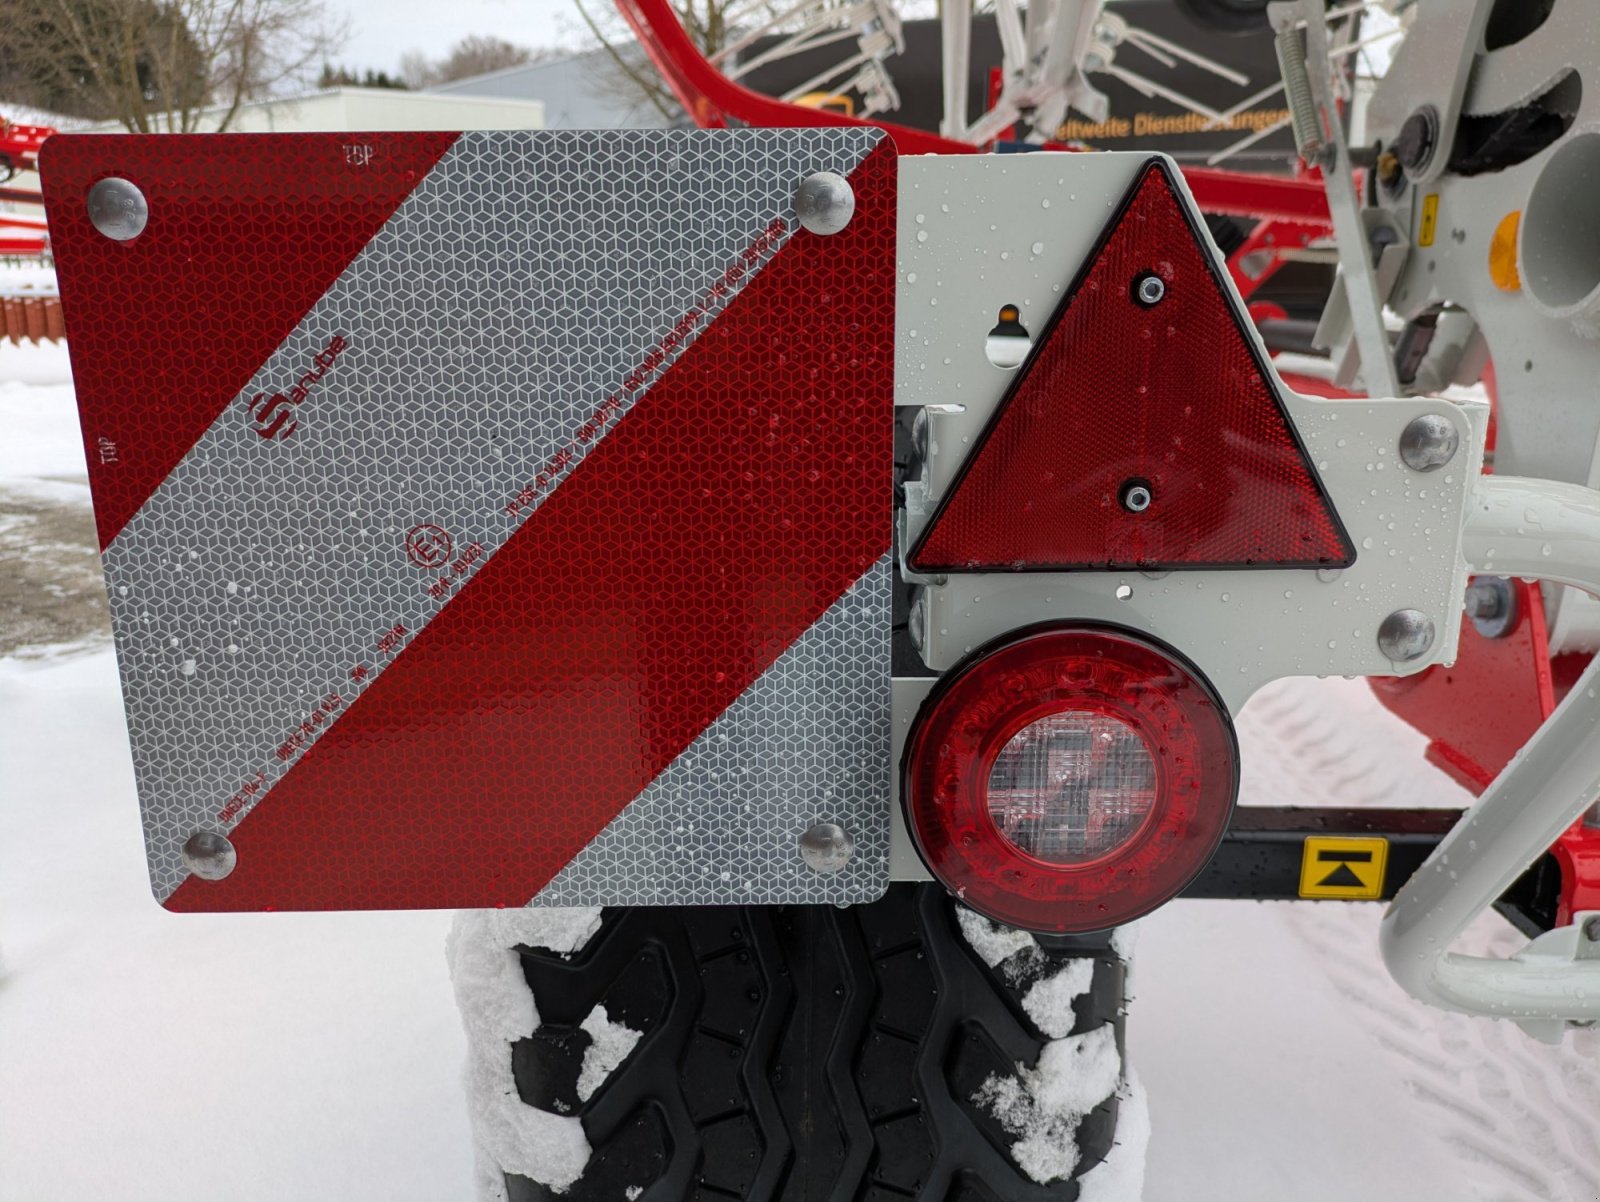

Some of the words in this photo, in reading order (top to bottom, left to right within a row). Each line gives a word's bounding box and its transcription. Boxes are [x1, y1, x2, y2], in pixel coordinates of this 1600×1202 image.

[342, 144, 374, 166] TOP
[98, 436, 119, 465] TOP
[276, 732, 302, 761] UNECE
